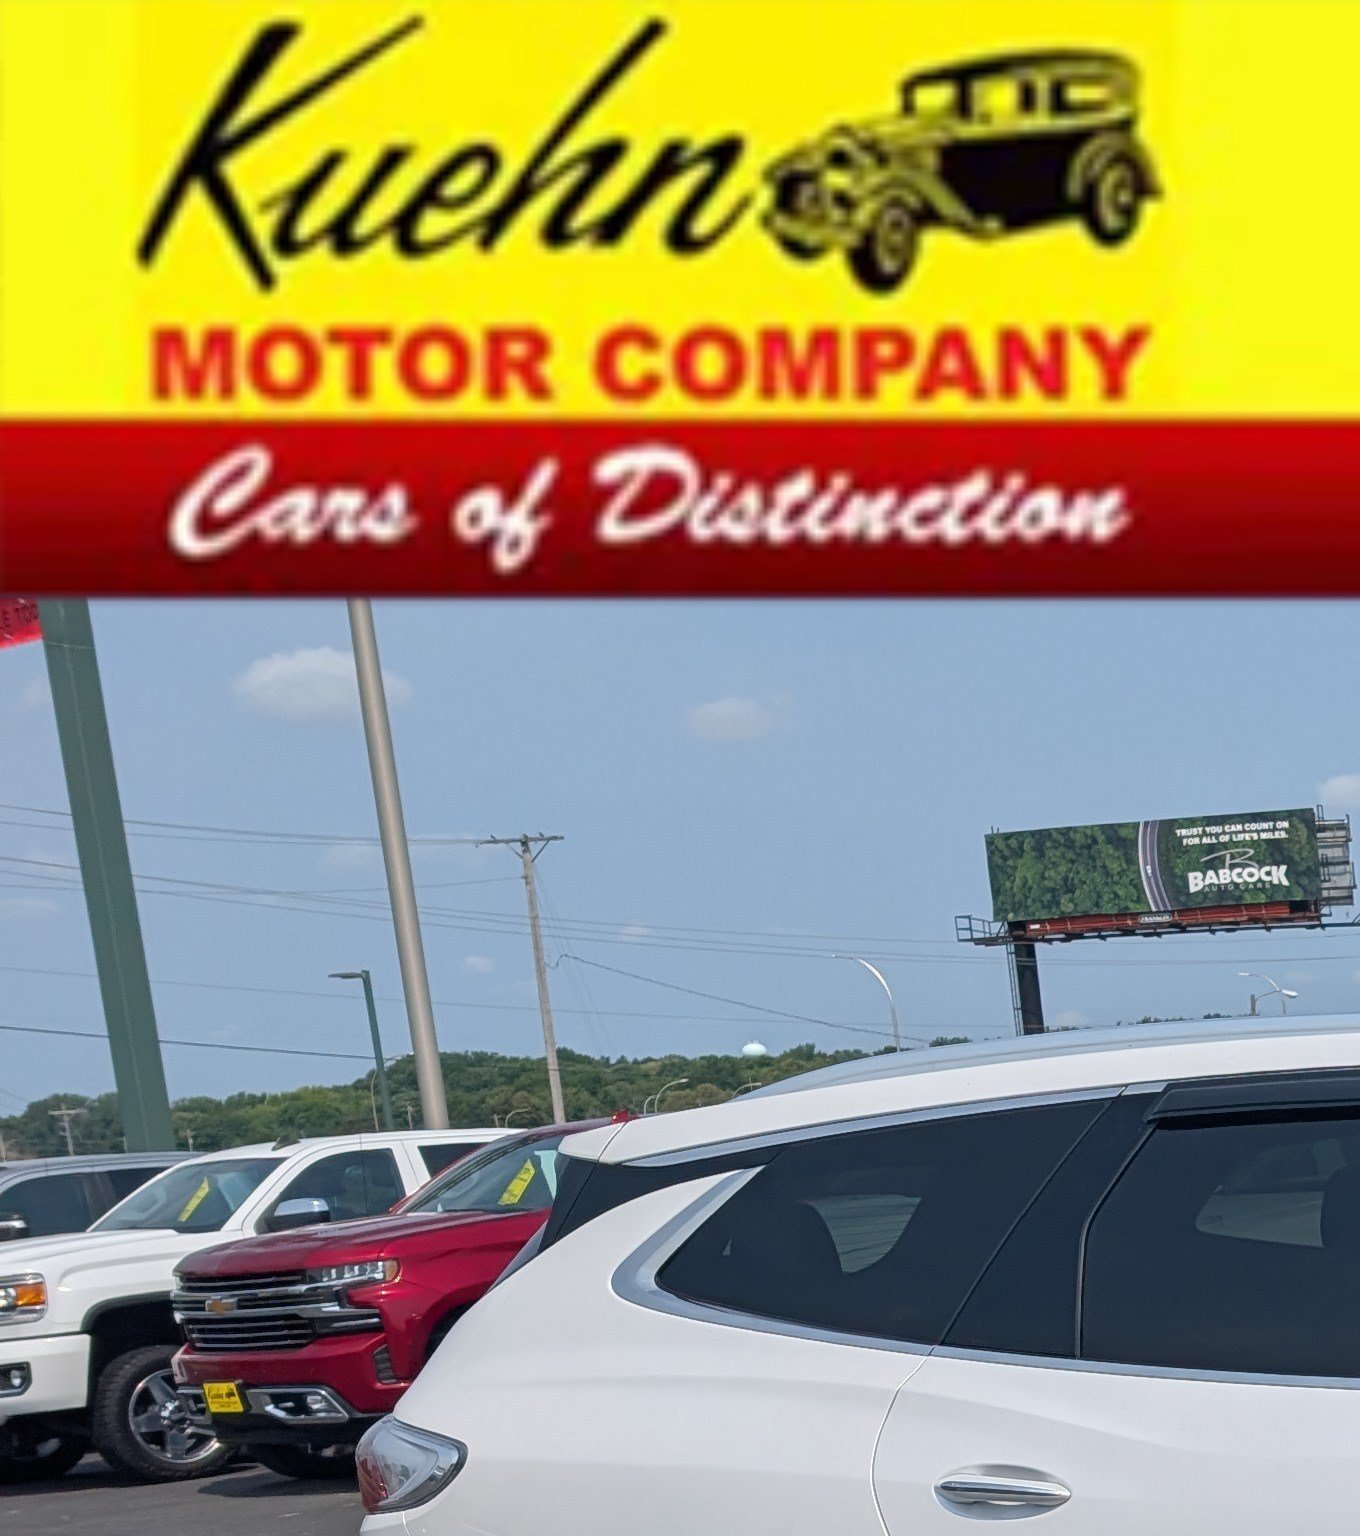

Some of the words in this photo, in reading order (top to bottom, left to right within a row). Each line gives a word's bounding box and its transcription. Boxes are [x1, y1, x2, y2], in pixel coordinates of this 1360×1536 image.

[1175, 827, 1203, 837] TRUST
[1205, 826, 1222, 834] YOU
[1224, 824, 1242, 833] CAN
[1244, 821, 1274, 830] COUNT
[1276, 821, 1289, 829] ON
[1183, 837, 1200, 846] FOR
[1202, 836, 1218, 844] ALL
[1219, 834, 1230, 842] OF
[1188, 864, 1290, 893] BABCOCK
[1203, 883, 1235, 892] AUTO
[1240, 881, 1271, 890] CARE
